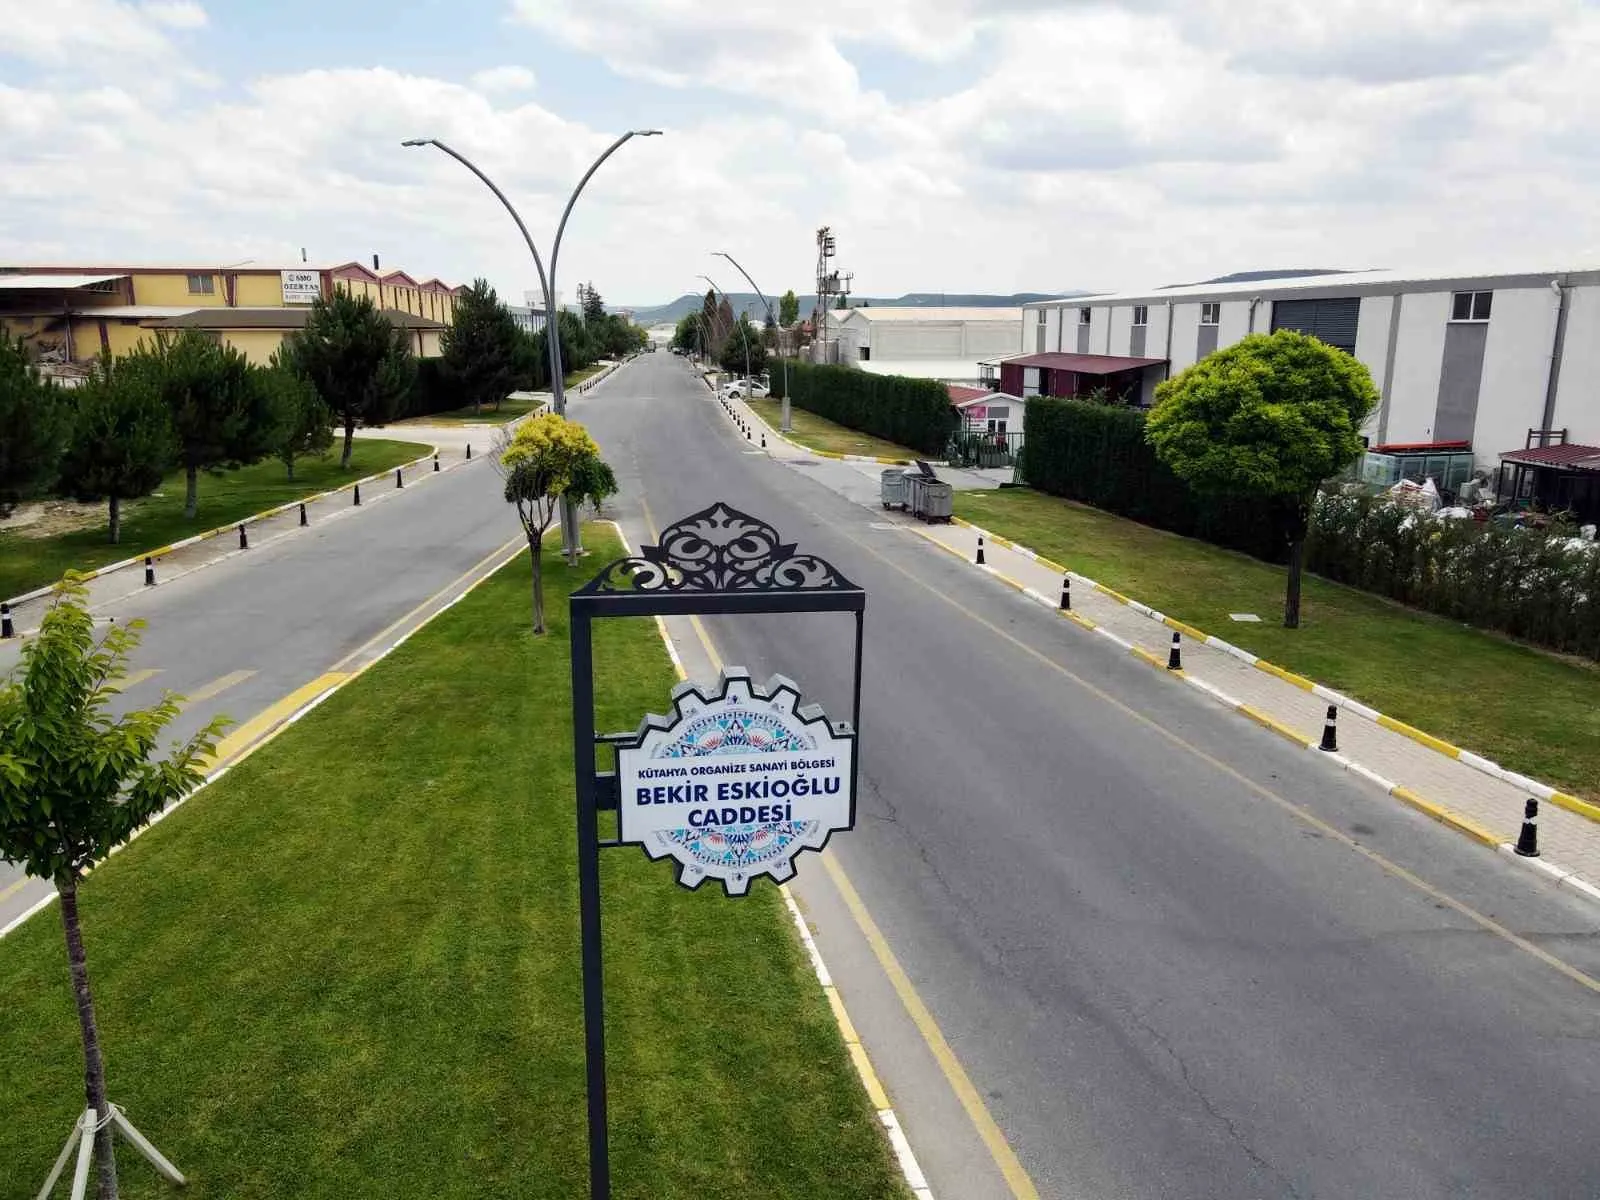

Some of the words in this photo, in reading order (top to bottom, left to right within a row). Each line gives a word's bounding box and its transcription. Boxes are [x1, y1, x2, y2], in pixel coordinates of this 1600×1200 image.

[638, 767, 688, 779] KÜTAHYA
[690, 763, 746, 776] ORGANİZE
[749, 760, 788, 773] SANAYİ
[790, 757, 835, 770] BÖLGESİ
[637, 779, 708, 805] BEKİR
[717, 774, 840, 801] ESKİOĞLU
[688, 800, 791, 827] CADDESİ
